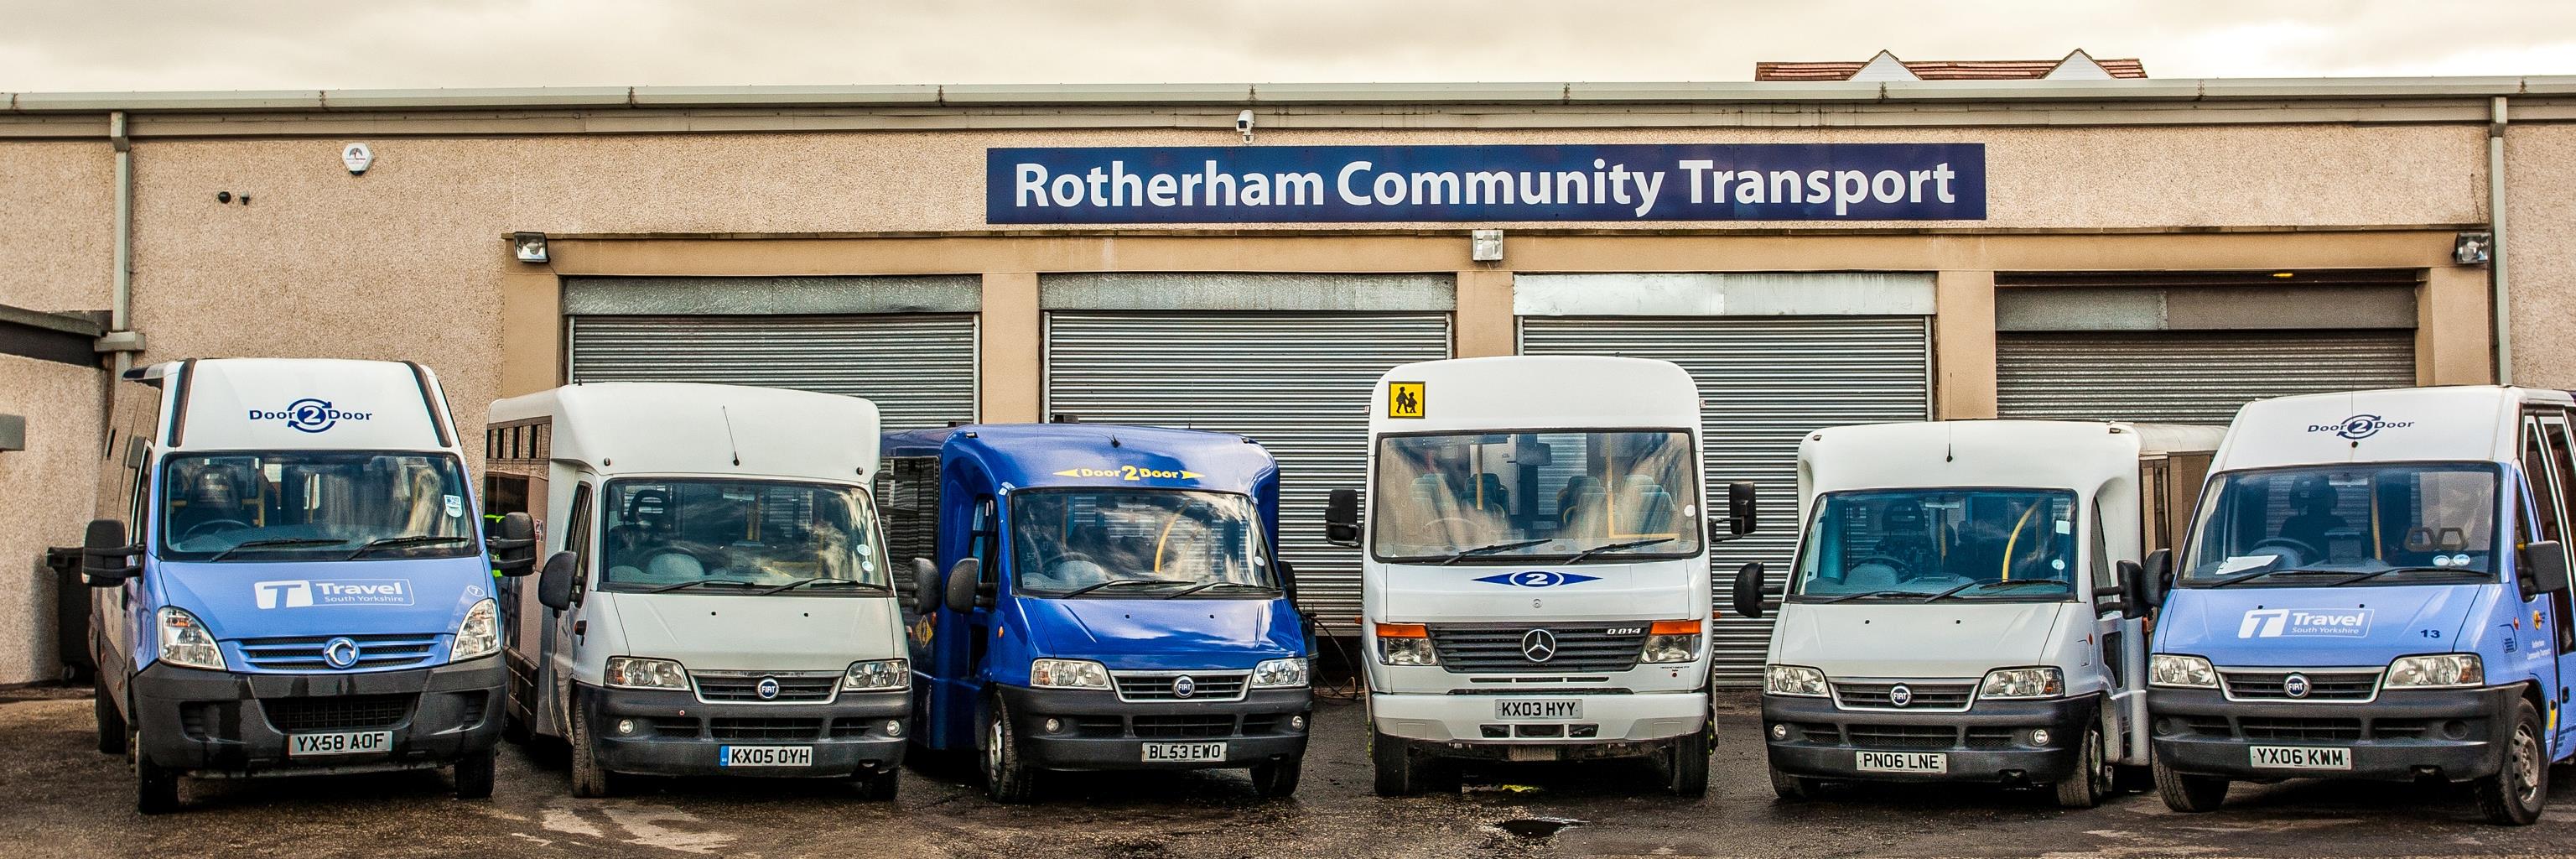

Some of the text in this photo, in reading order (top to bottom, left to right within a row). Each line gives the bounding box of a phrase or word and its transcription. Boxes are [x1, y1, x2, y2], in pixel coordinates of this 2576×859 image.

[1016, 158, 1955, 218] Rotherham Community Transport
[249, 409, 295, 420] Door
[327, 409, 373, 420] Door
[2307, 424, 2347, 433] Door
[1525, 573, 1549, 585] 2
[315, 581, 403, 596] Travel
[352, 595, 404, 603] Yorkshire
[2292, 612, 2365, 627] Travel
[2319, 627, 2360, 635] Yorkshire
[2420, 629, 2441, 638] 13
[761, 685, 776, 694] FIAT
[1178, 683, 1192, 691] FIAT
[2288, 682, 2303, 691] FIAT
[1893, 692, 1908, 700] FIAT
[1502, 702, 1576, 716] KX03 HYY
[297, 732, 385, 752] YX58 AOF
[731, 749, 774, 763] KX05
[778, 749, 810, 763] OYH
[1148, 744, 1221, 759] BL53 EWO
[2257, 748, 2344, 766] YX06 KWM
[1863, 753, 1940, 769] PN06 LNE
